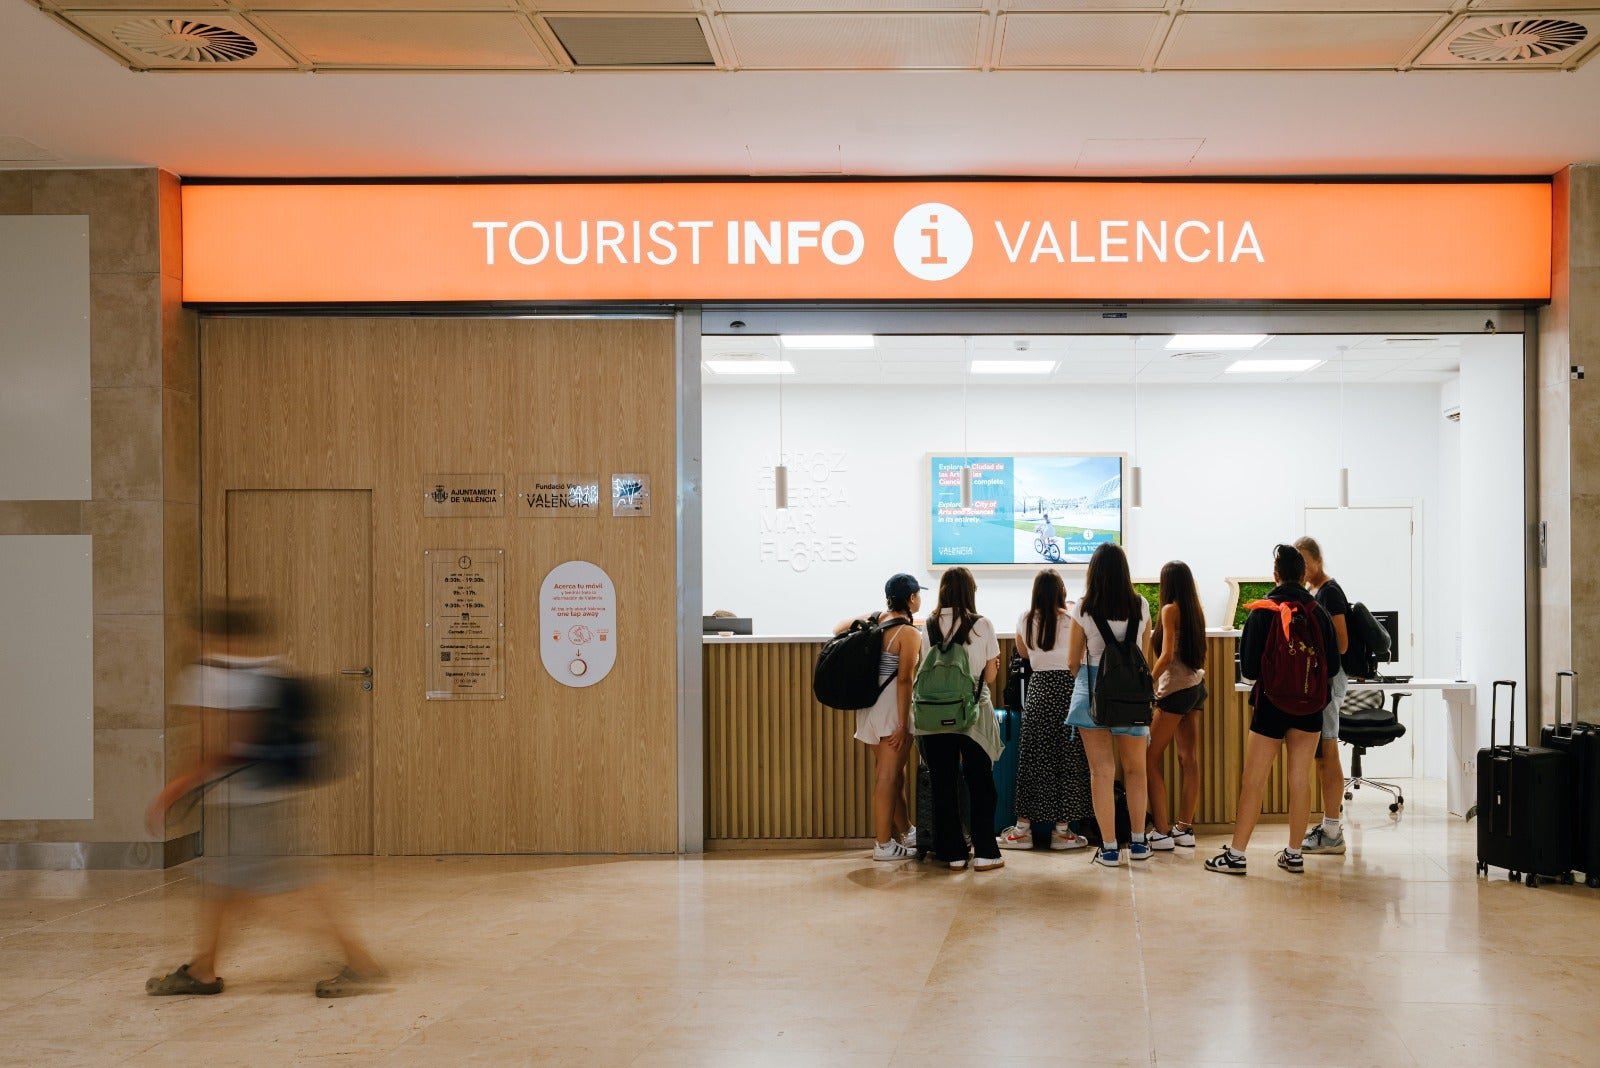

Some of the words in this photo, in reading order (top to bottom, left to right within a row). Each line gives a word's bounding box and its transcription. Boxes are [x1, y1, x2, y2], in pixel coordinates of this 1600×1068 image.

[472, 220, 713, 265] TOURIST
[727, 220, 865, 266] INFO
[994, 220, 1265, 263] VALENCIA
[451, 488, 497, 496] AJUNTAMENT
[974, 478, 1006, 486] completo.
[760, 512, 816, 534] MAR
[760, 536, 858, 573] FLORES
